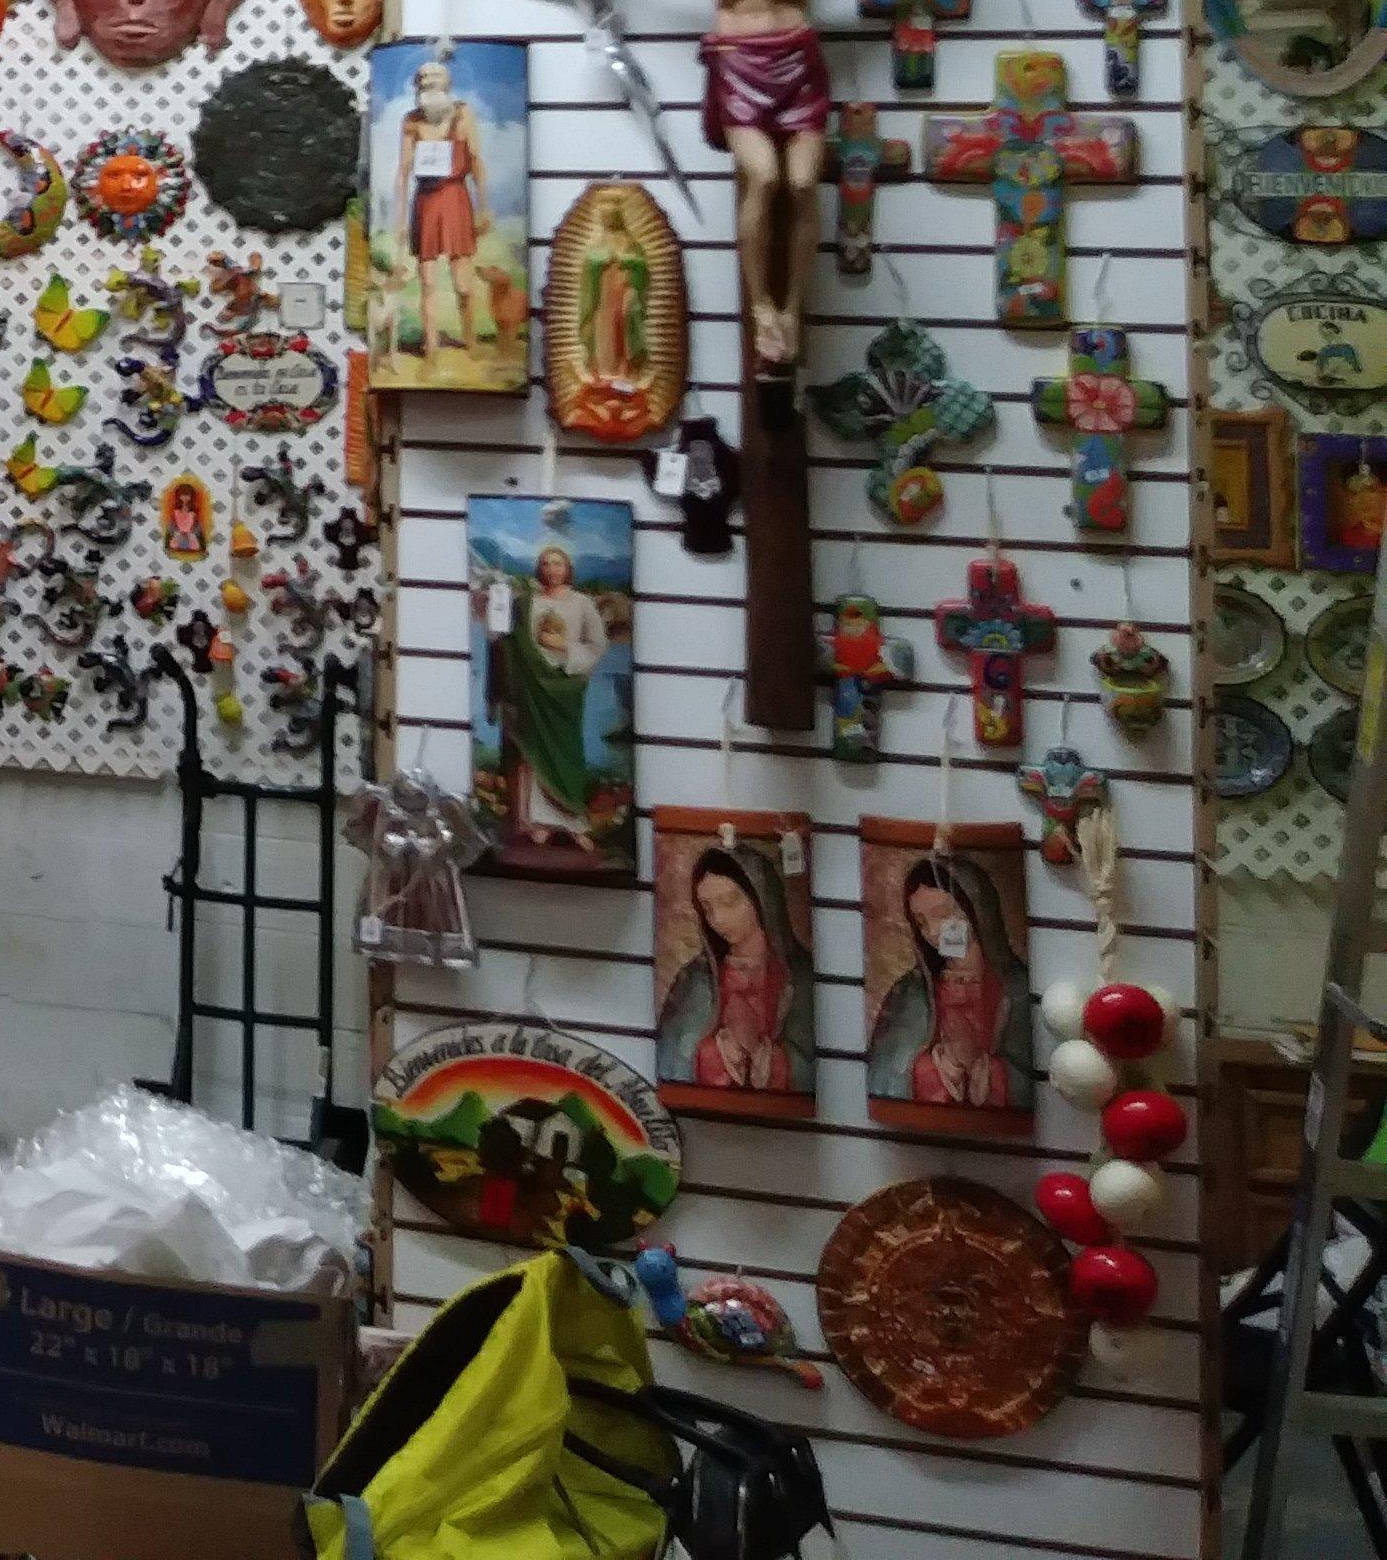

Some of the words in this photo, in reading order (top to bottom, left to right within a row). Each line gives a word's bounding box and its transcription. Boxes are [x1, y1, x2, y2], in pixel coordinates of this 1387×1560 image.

[1286, 303, 1368, 323] COCINA
[18, 1285, 115, 1333] Large
[141, 1311, 246, 1347] Grande
[40, 1411, 212, 1460] Walmart.com
